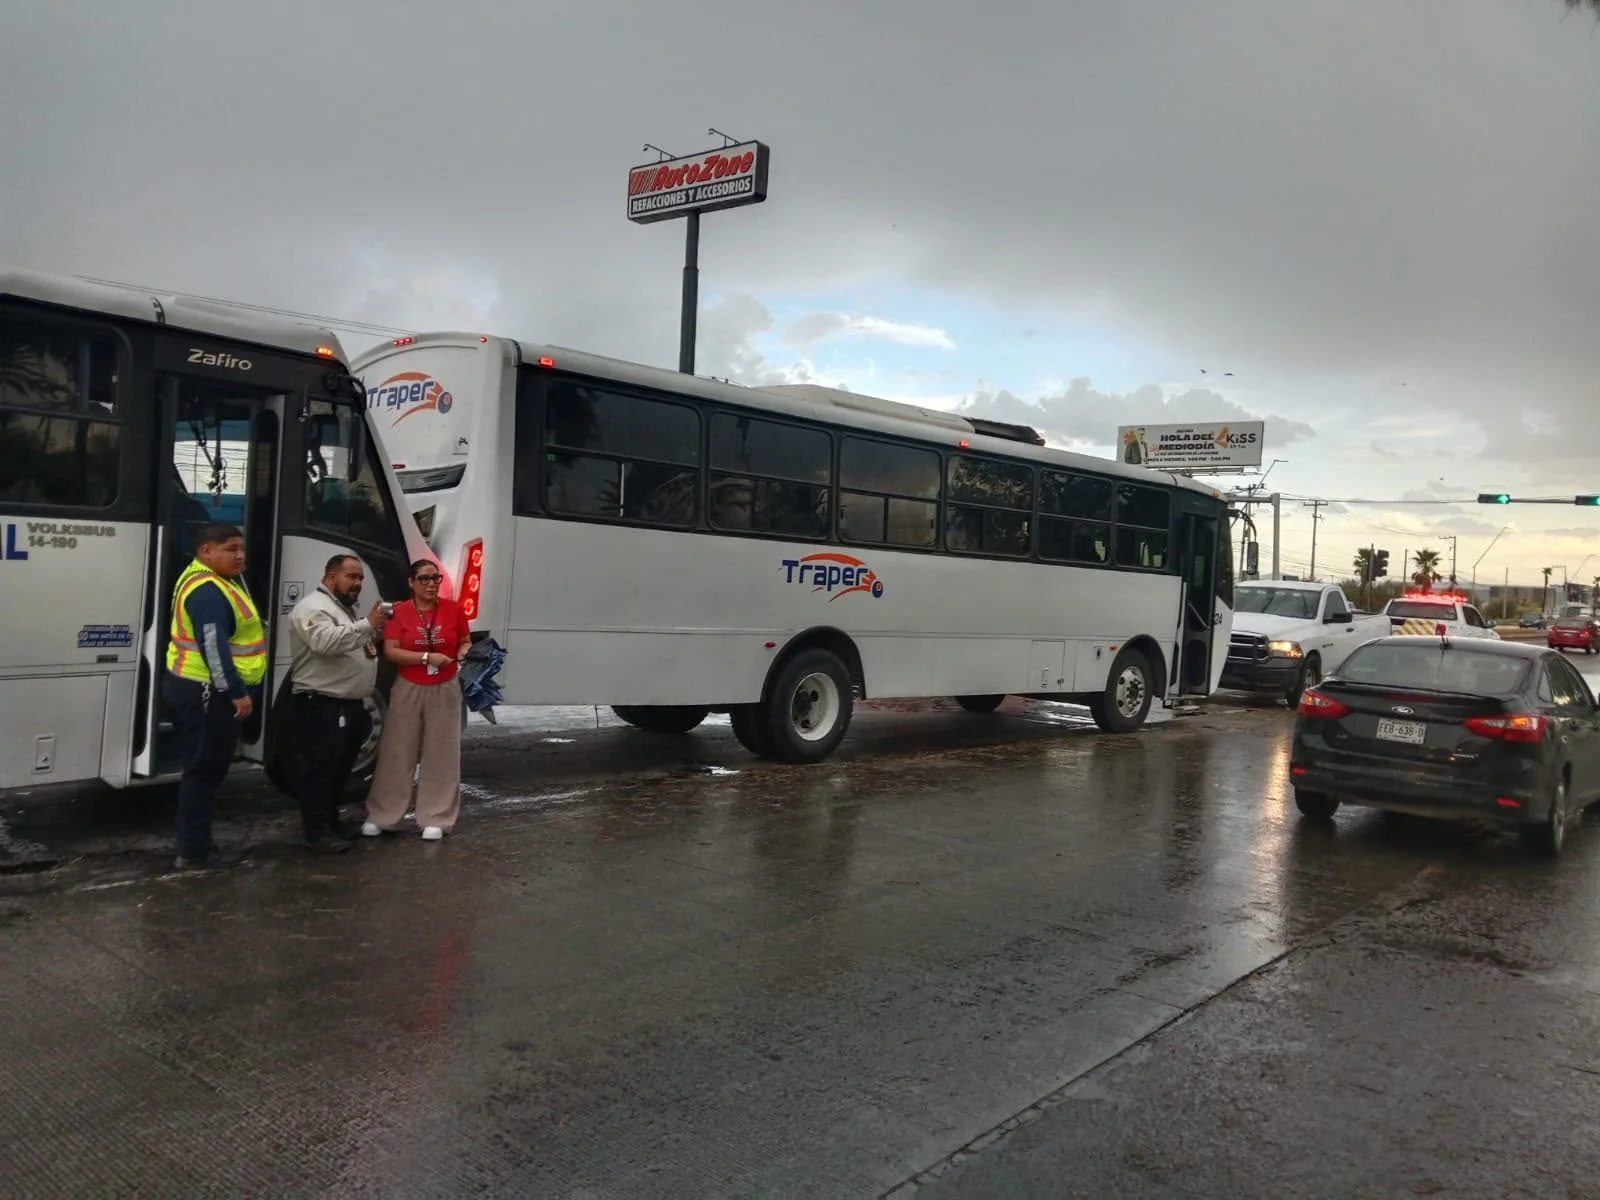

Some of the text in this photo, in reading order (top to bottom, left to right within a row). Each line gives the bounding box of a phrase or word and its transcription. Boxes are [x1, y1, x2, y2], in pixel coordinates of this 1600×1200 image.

[650, 151, 755, 192] AutoZone
[632, 177, 751, 213] REFACCIONES Y ACCESORIOS
[187, 349, 252, 371] Zafiro
[367, 381, 434, 409] Traper
[1158, 442, 1215, 450] MEDIODÍA
[1160, 433, 1215, 442] HOLA DEL
[27, 522, 116, 537] VOLKSBUS
[28, 535, 77, 549] 14-190
[782, 559, 868, 591] Traper
